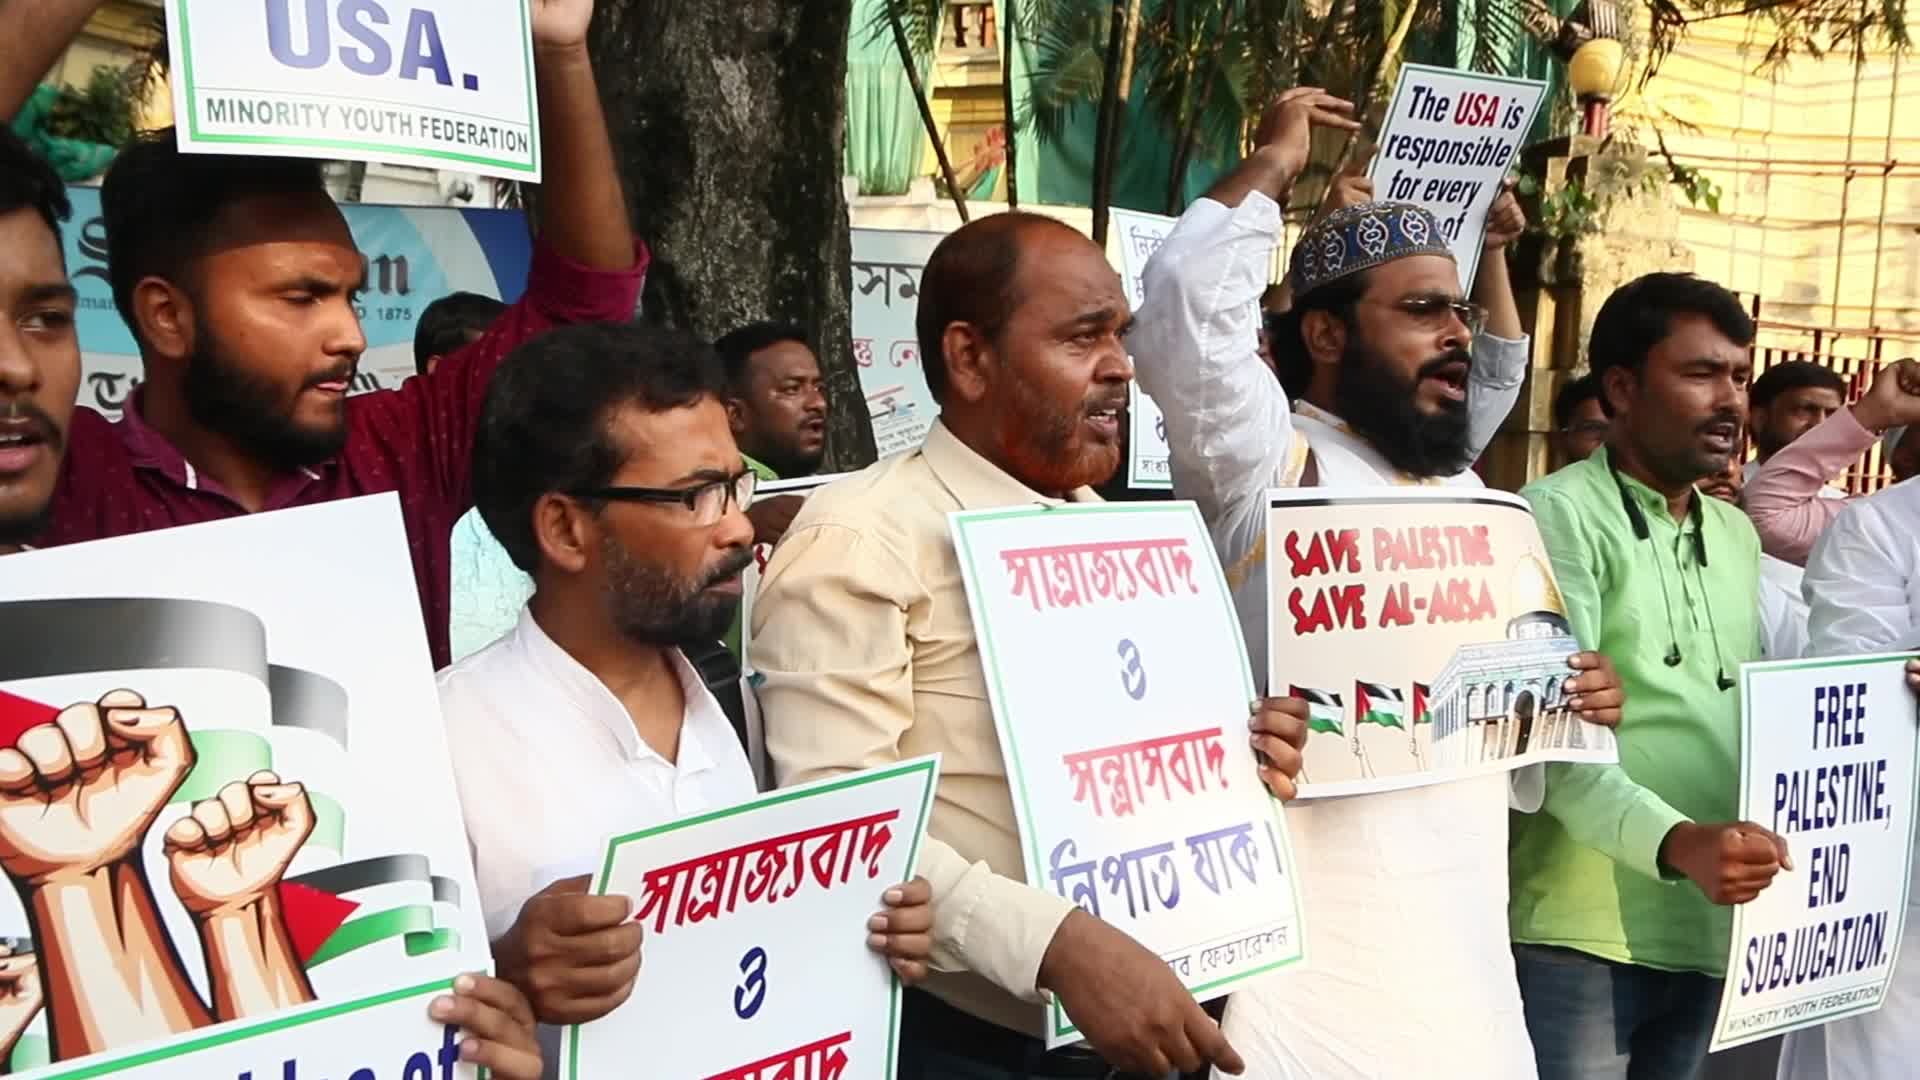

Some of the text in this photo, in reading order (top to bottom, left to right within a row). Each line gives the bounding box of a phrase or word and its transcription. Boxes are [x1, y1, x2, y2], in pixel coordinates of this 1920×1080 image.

[265, 0, 479, 91] USA.
[206, 97, 528, 153] MINORITY YOUTH FEDERATION
[1408, 85, 1524, 130] The USA is
[1385, 133, 1512, 169] responsible
[1388, 169, 1482, 210] for every
[1443, 211, 1468, 240] of
[377, 308, 412, 321] 1875
[1000, 538, 1199, 612] সাম্রাজ্যবাদ
[1285, 525, 1494, 578] SAVE PALESTINE
[1288, 584, 1367, 635] SAVE
[1117, 638, 1147, 701] ও
[1812, 683, 1867, 750] FREE
[1062, 727, 1229, 817] সন্ত্রাসবাদ
[1773, 759, 1891, 834] PALESTINE,
[634, 809, 900, 934] সাম্রাজ্যবাদ
[1049, 838, 1181, 919] নিপাত
[1808, 843, 1850, 908] END
[1200, 926, 1289, 973] ফেডারেশন
[1740, 910, 1888, 997] SUBJUGATION.
[734, 946, 768, 1019] ও
[1727, 984, 1881, 1033] MINORITY YOUTH FEDERATION
